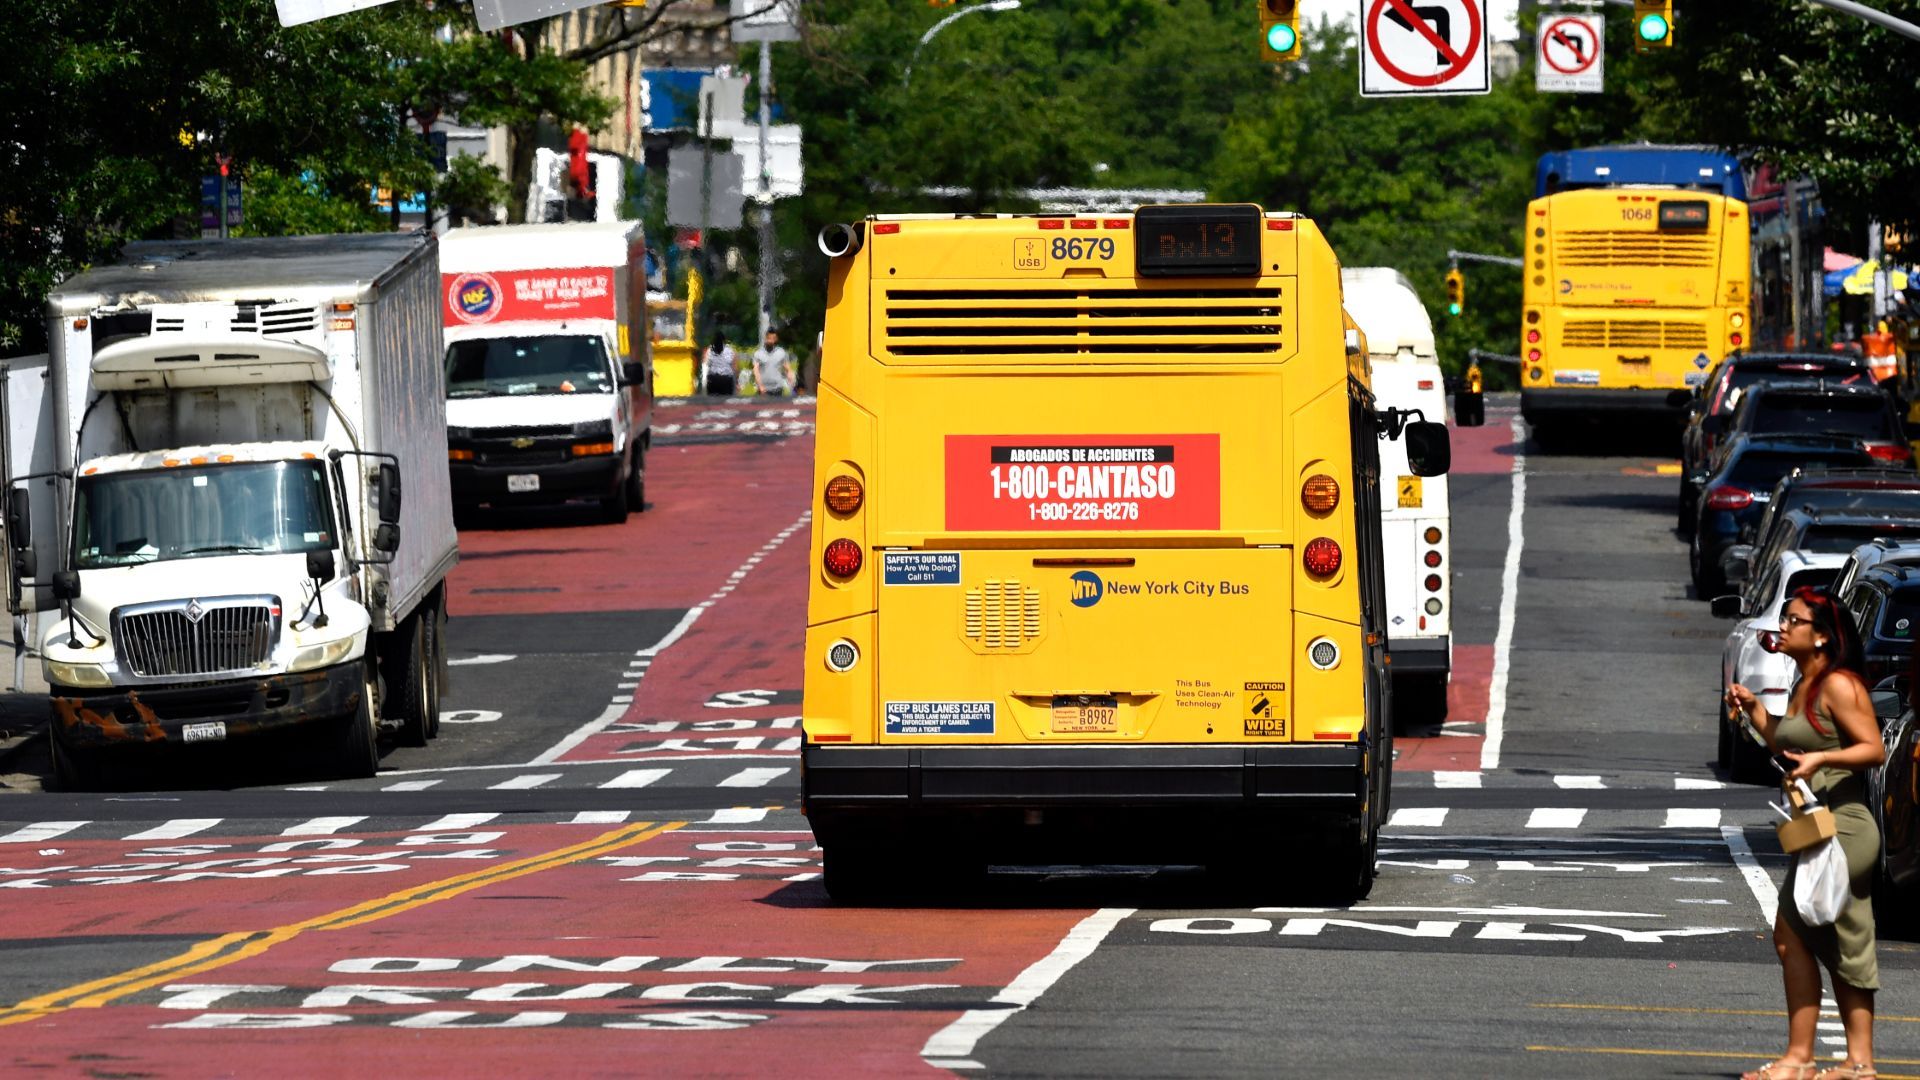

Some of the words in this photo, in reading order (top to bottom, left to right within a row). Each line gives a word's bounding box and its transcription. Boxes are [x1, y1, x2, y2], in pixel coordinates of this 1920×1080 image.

[1622, 208, 1652, 220] 1068
[1052, 237, 1114, 260] 8679
[1018, 258, 1040, 266] USB
[1010, 448, 1070, 462] ABOGADOS
[1073, 448, 1086, 462] DE
[1088, 448, 1154, 462] ACCIDENTES
[990, 465, 1176, 499] 1-800-CANTASO
[1029, 502, 1138, 521] 1-800-226-8276
[886, 556, 920, 564] SAFETY'S
[932, 564, 956, 572] Doing?
[1070, 579, 1098, 600] MTA
[1107, 581, 1141, 594] New
[1145, 581, 1179, 594] York
[1183, 581, 1215, 597] City
[1220, 581, 1250, 594] Bus
[888, 704, 910, 713] KEEP
[912, 704, 930, 713] BUS
[932, 704, 960, 713] LANES
[962, 704, 990, 713] CLEAR
[1176, 700, 1221, 709] Technology
[1246, 720, 1284, 730] WIDE
[1149, 917, 1742, 942] ONLY
[328, 955, 964, 972] ONLY
[158, 982, 962, 1008] TRUCK
[147, 1011, 769, 1030] BUS
